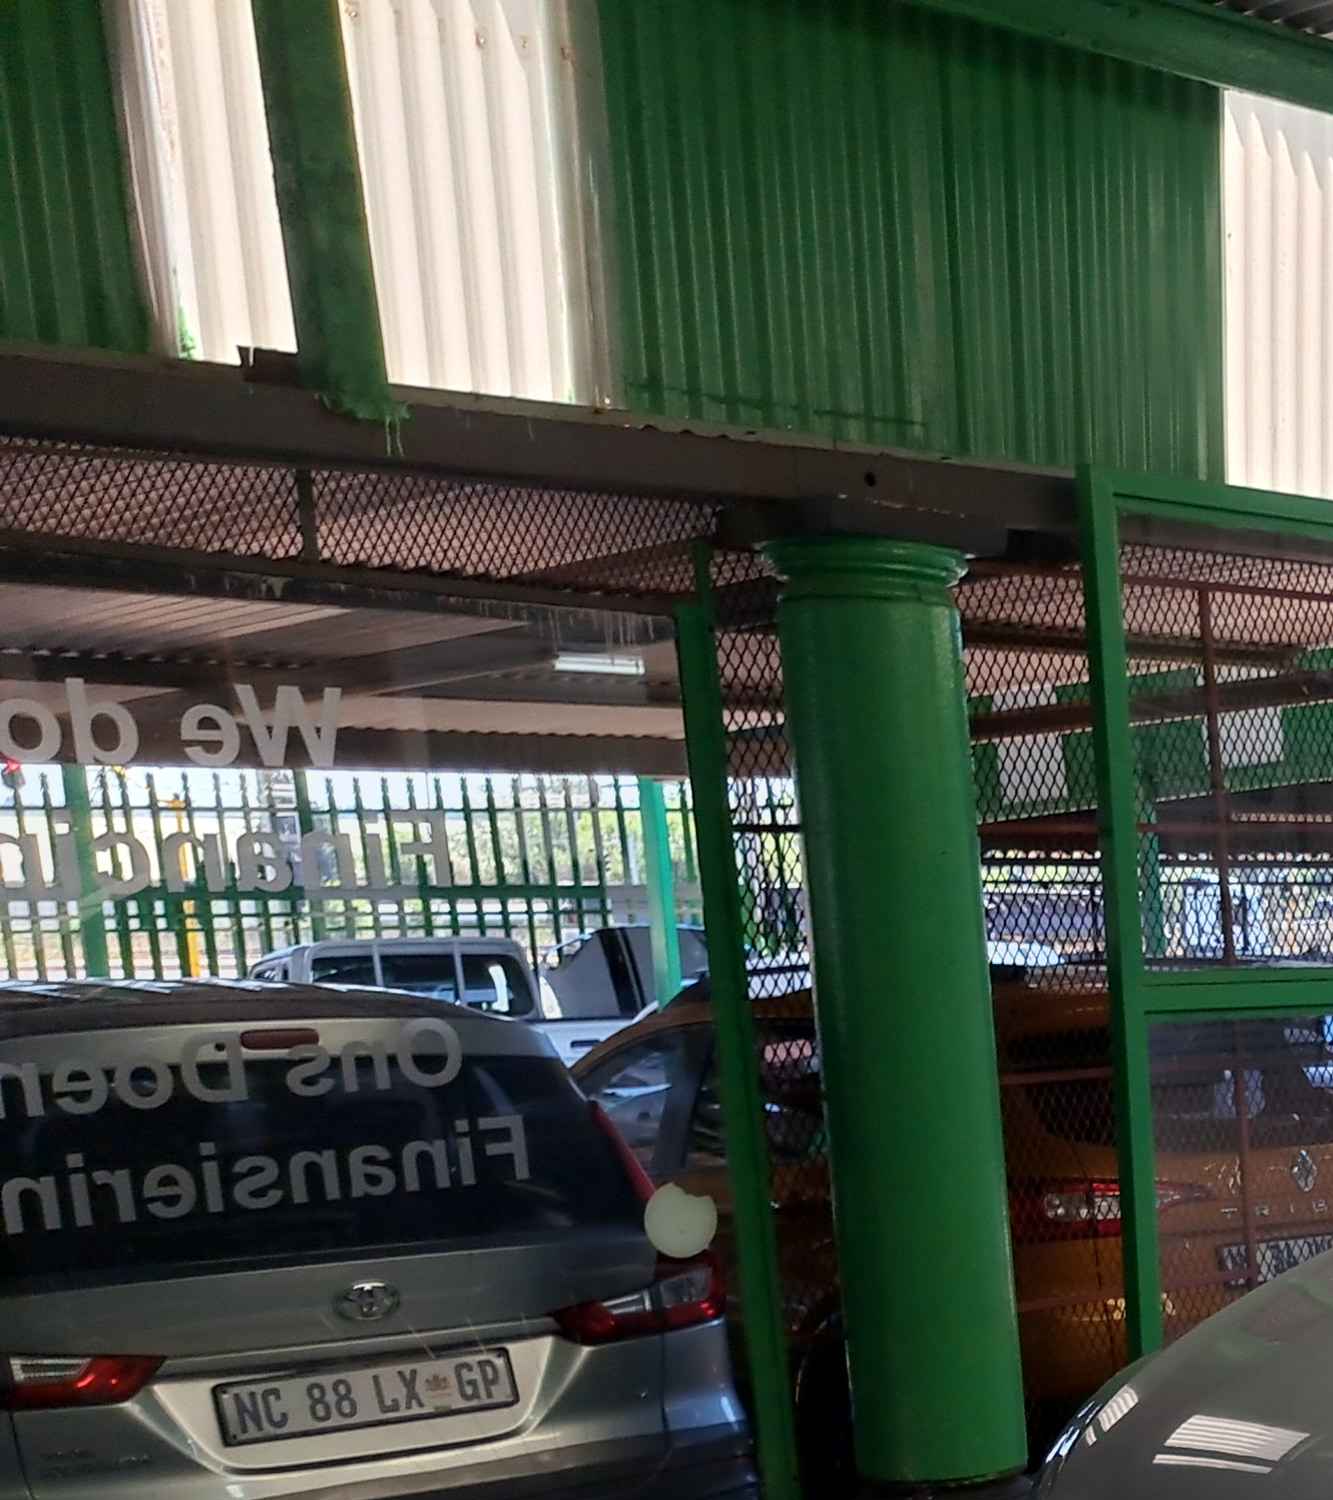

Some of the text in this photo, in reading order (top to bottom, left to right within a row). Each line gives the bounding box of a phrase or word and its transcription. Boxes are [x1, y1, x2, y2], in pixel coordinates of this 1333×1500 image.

[234, 1359, 499, 1434] NC 88 LX GP
